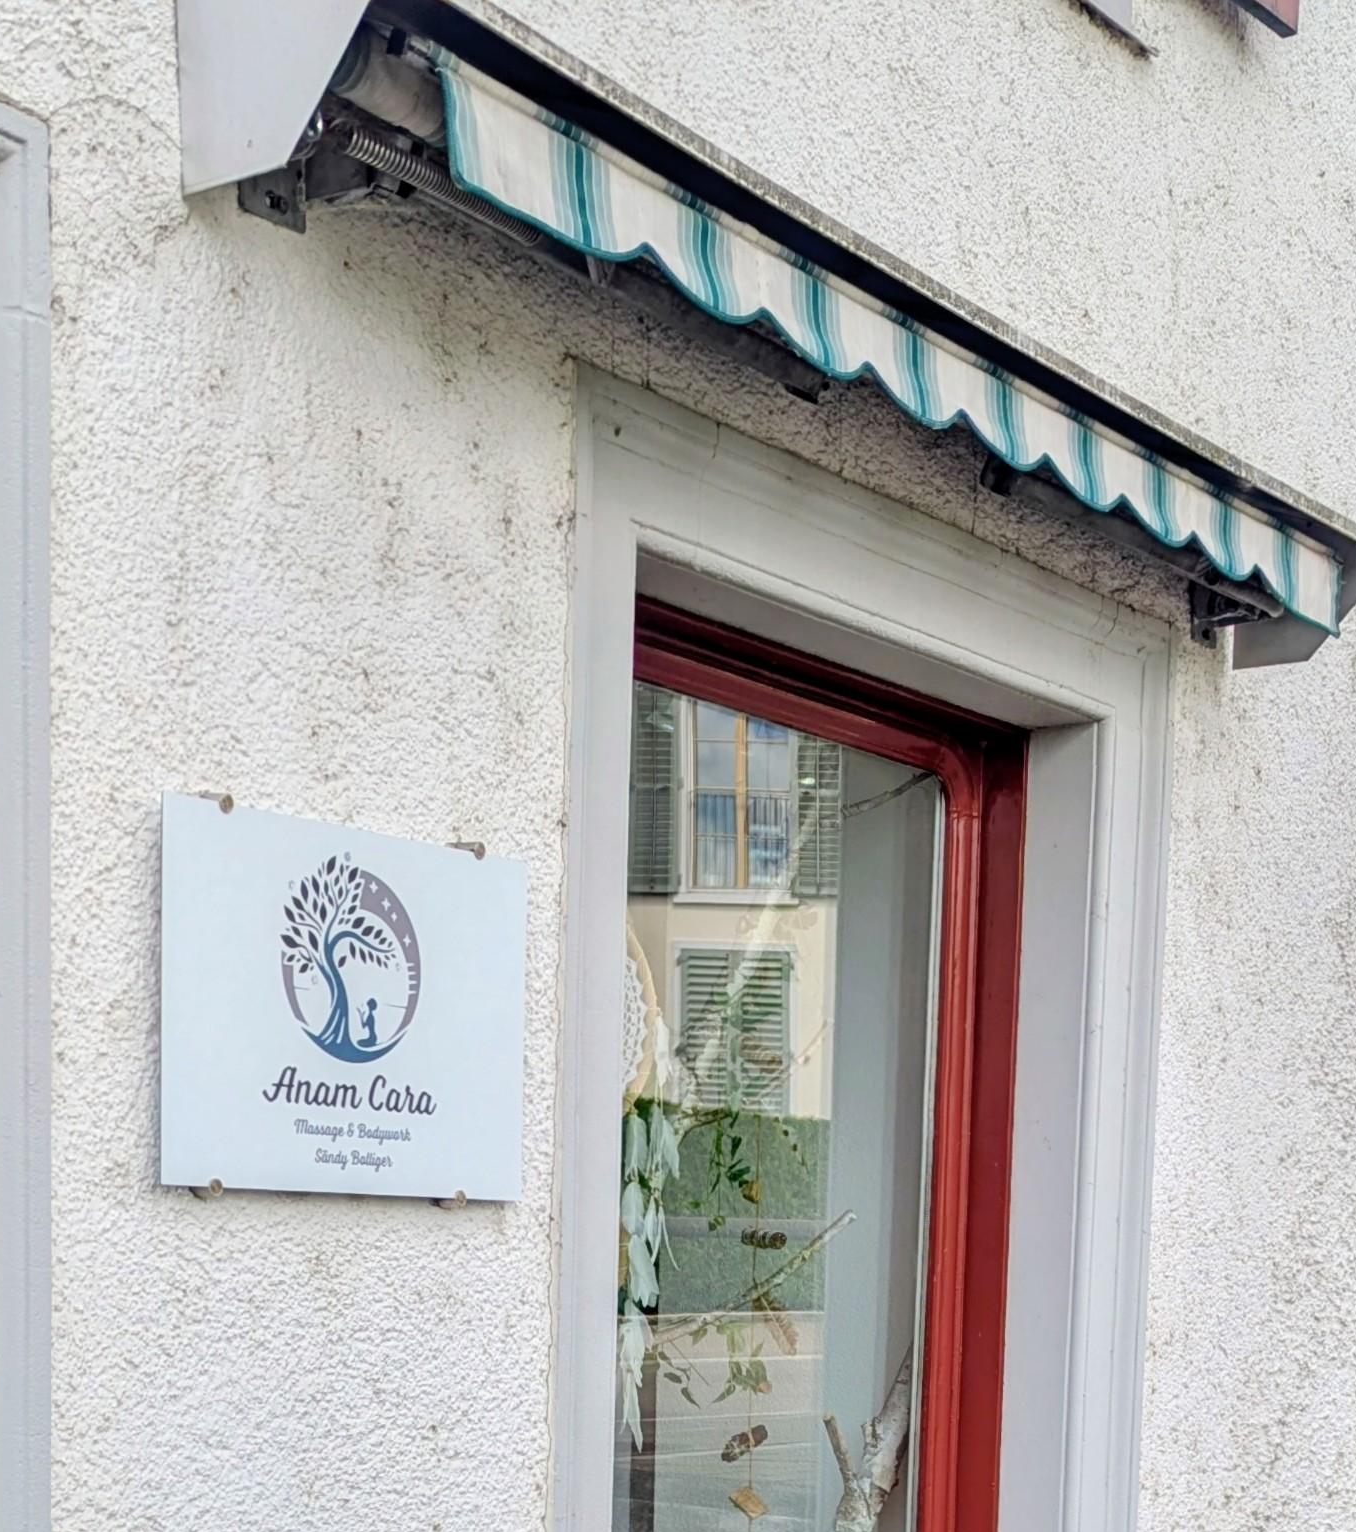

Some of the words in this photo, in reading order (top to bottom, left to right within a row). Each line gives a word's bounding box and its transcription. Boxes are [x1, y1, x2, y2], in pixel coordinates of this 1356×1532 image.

[262, 1065, 363, 1109] Anam
[368, 1074, 437, 1116] Cara
[293, 1118, 344, 1143] Massage
[346, 1122, 355, 1138] &
[357, 1123, 412, 1146] Bodywork
[350, 1150, 394, 1173] Bolliger
